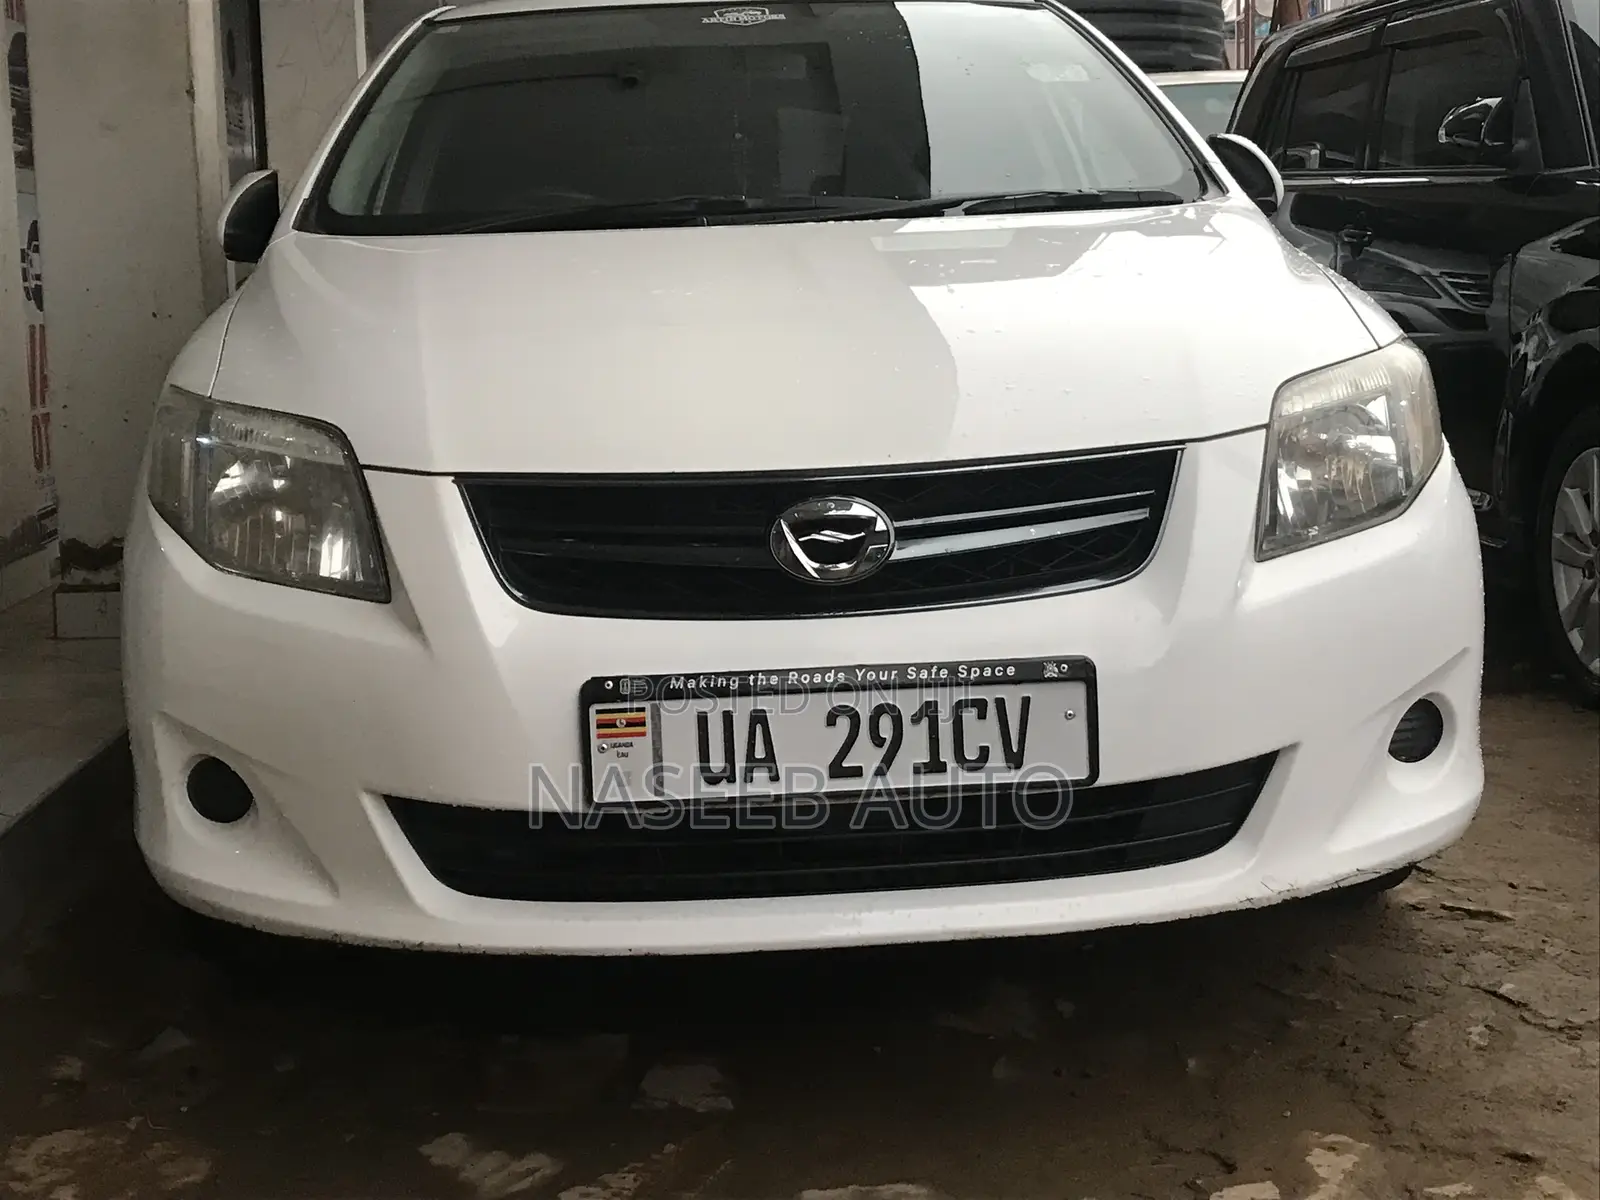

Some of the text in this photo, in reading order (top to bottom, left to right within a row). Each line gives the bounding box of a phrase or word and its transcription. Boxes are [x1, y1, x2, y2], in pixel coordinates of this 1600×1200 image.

[669, 664, 1016, 690] Making the Roads Your Safe Space
[696, 695, 1031, 786] UA 291CV
